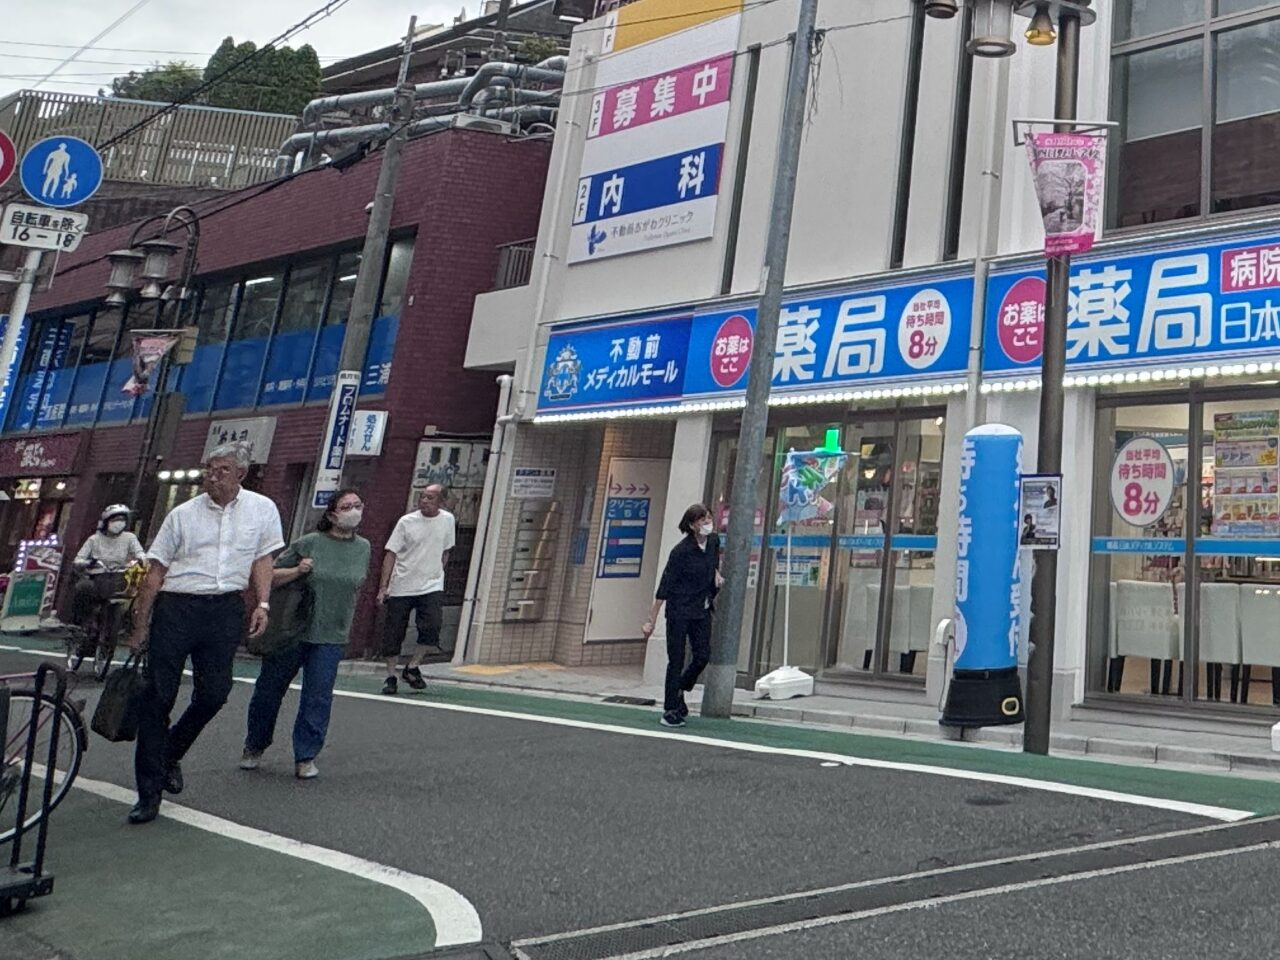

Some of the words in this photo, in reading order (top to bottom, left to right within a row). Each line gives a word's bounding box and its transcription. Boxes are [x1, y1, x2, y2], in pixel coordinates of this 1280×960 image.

[613, 64, 718, 130] 募集中
[599, 151, 706, 217] 内科
[10, 211, 84, 232] 自転車を除く
[1066, 253, 1213, 360] 薬局
[906, 311, 945, 329] 待ち時間
[610, 334, 661, 363] 不動前
[715, 335, 750, 356] お薬は
[774, 294, 887, 382] 薬局
[908, 330, 938, 359] 8分
[1013, 326, 1039, 347] ここ
[584, 359, 679, 390] メディカルモール
[720, 357, 738, 373] ここ
[360, 414, 378, 452] 処方せん
[1126, 448, 1161, 461] 当社平均
[1118, 463, 1166, 480] 待ち時間
[609, 499, 648, 509] クリニック
[1123, 482, 1160, 516] 8分
[608, 508, 647, 518] こちら
